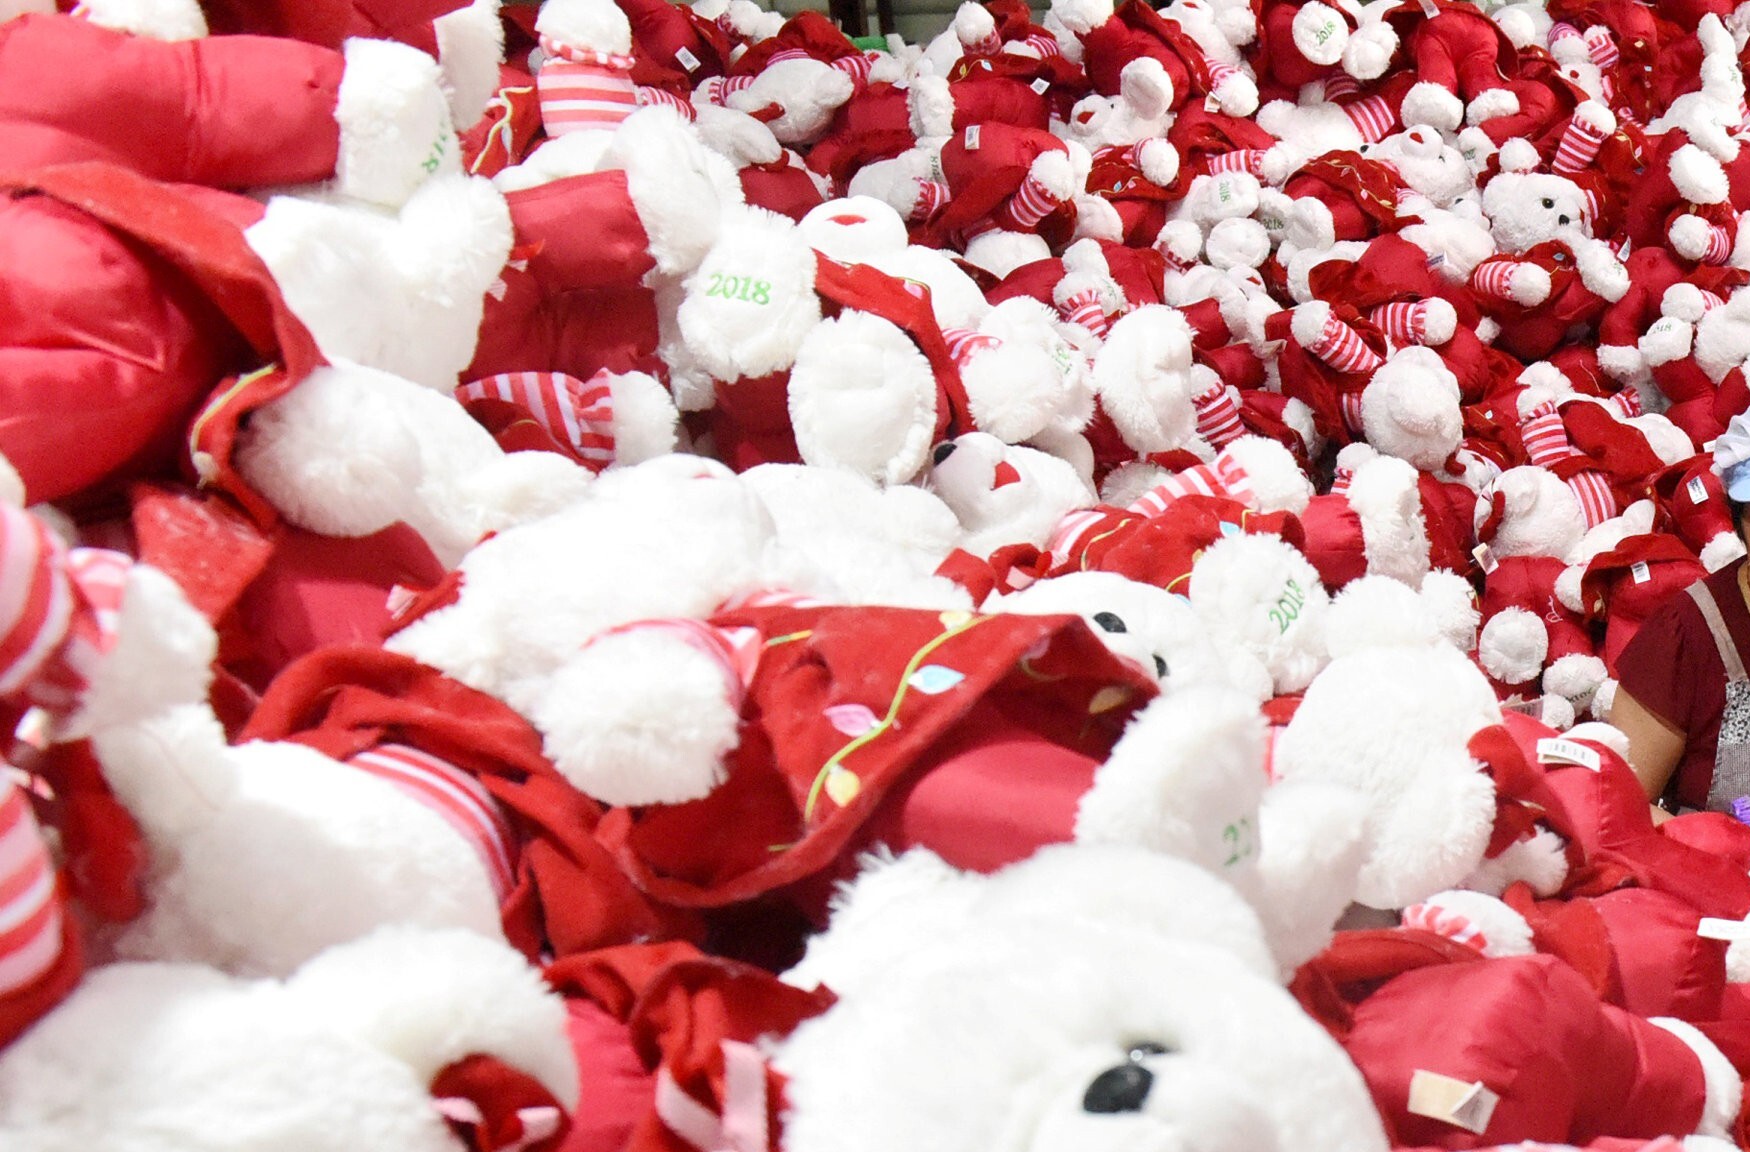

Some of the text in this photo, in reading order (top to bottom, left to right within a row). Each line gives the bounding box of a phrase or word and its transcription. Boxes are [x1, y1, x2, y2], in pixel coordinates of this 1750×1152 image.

[1315, 20, 1337, 47] 2018
[706, 273, 772, 306] 2018
[1269, 579, 1306, 634] 2018
